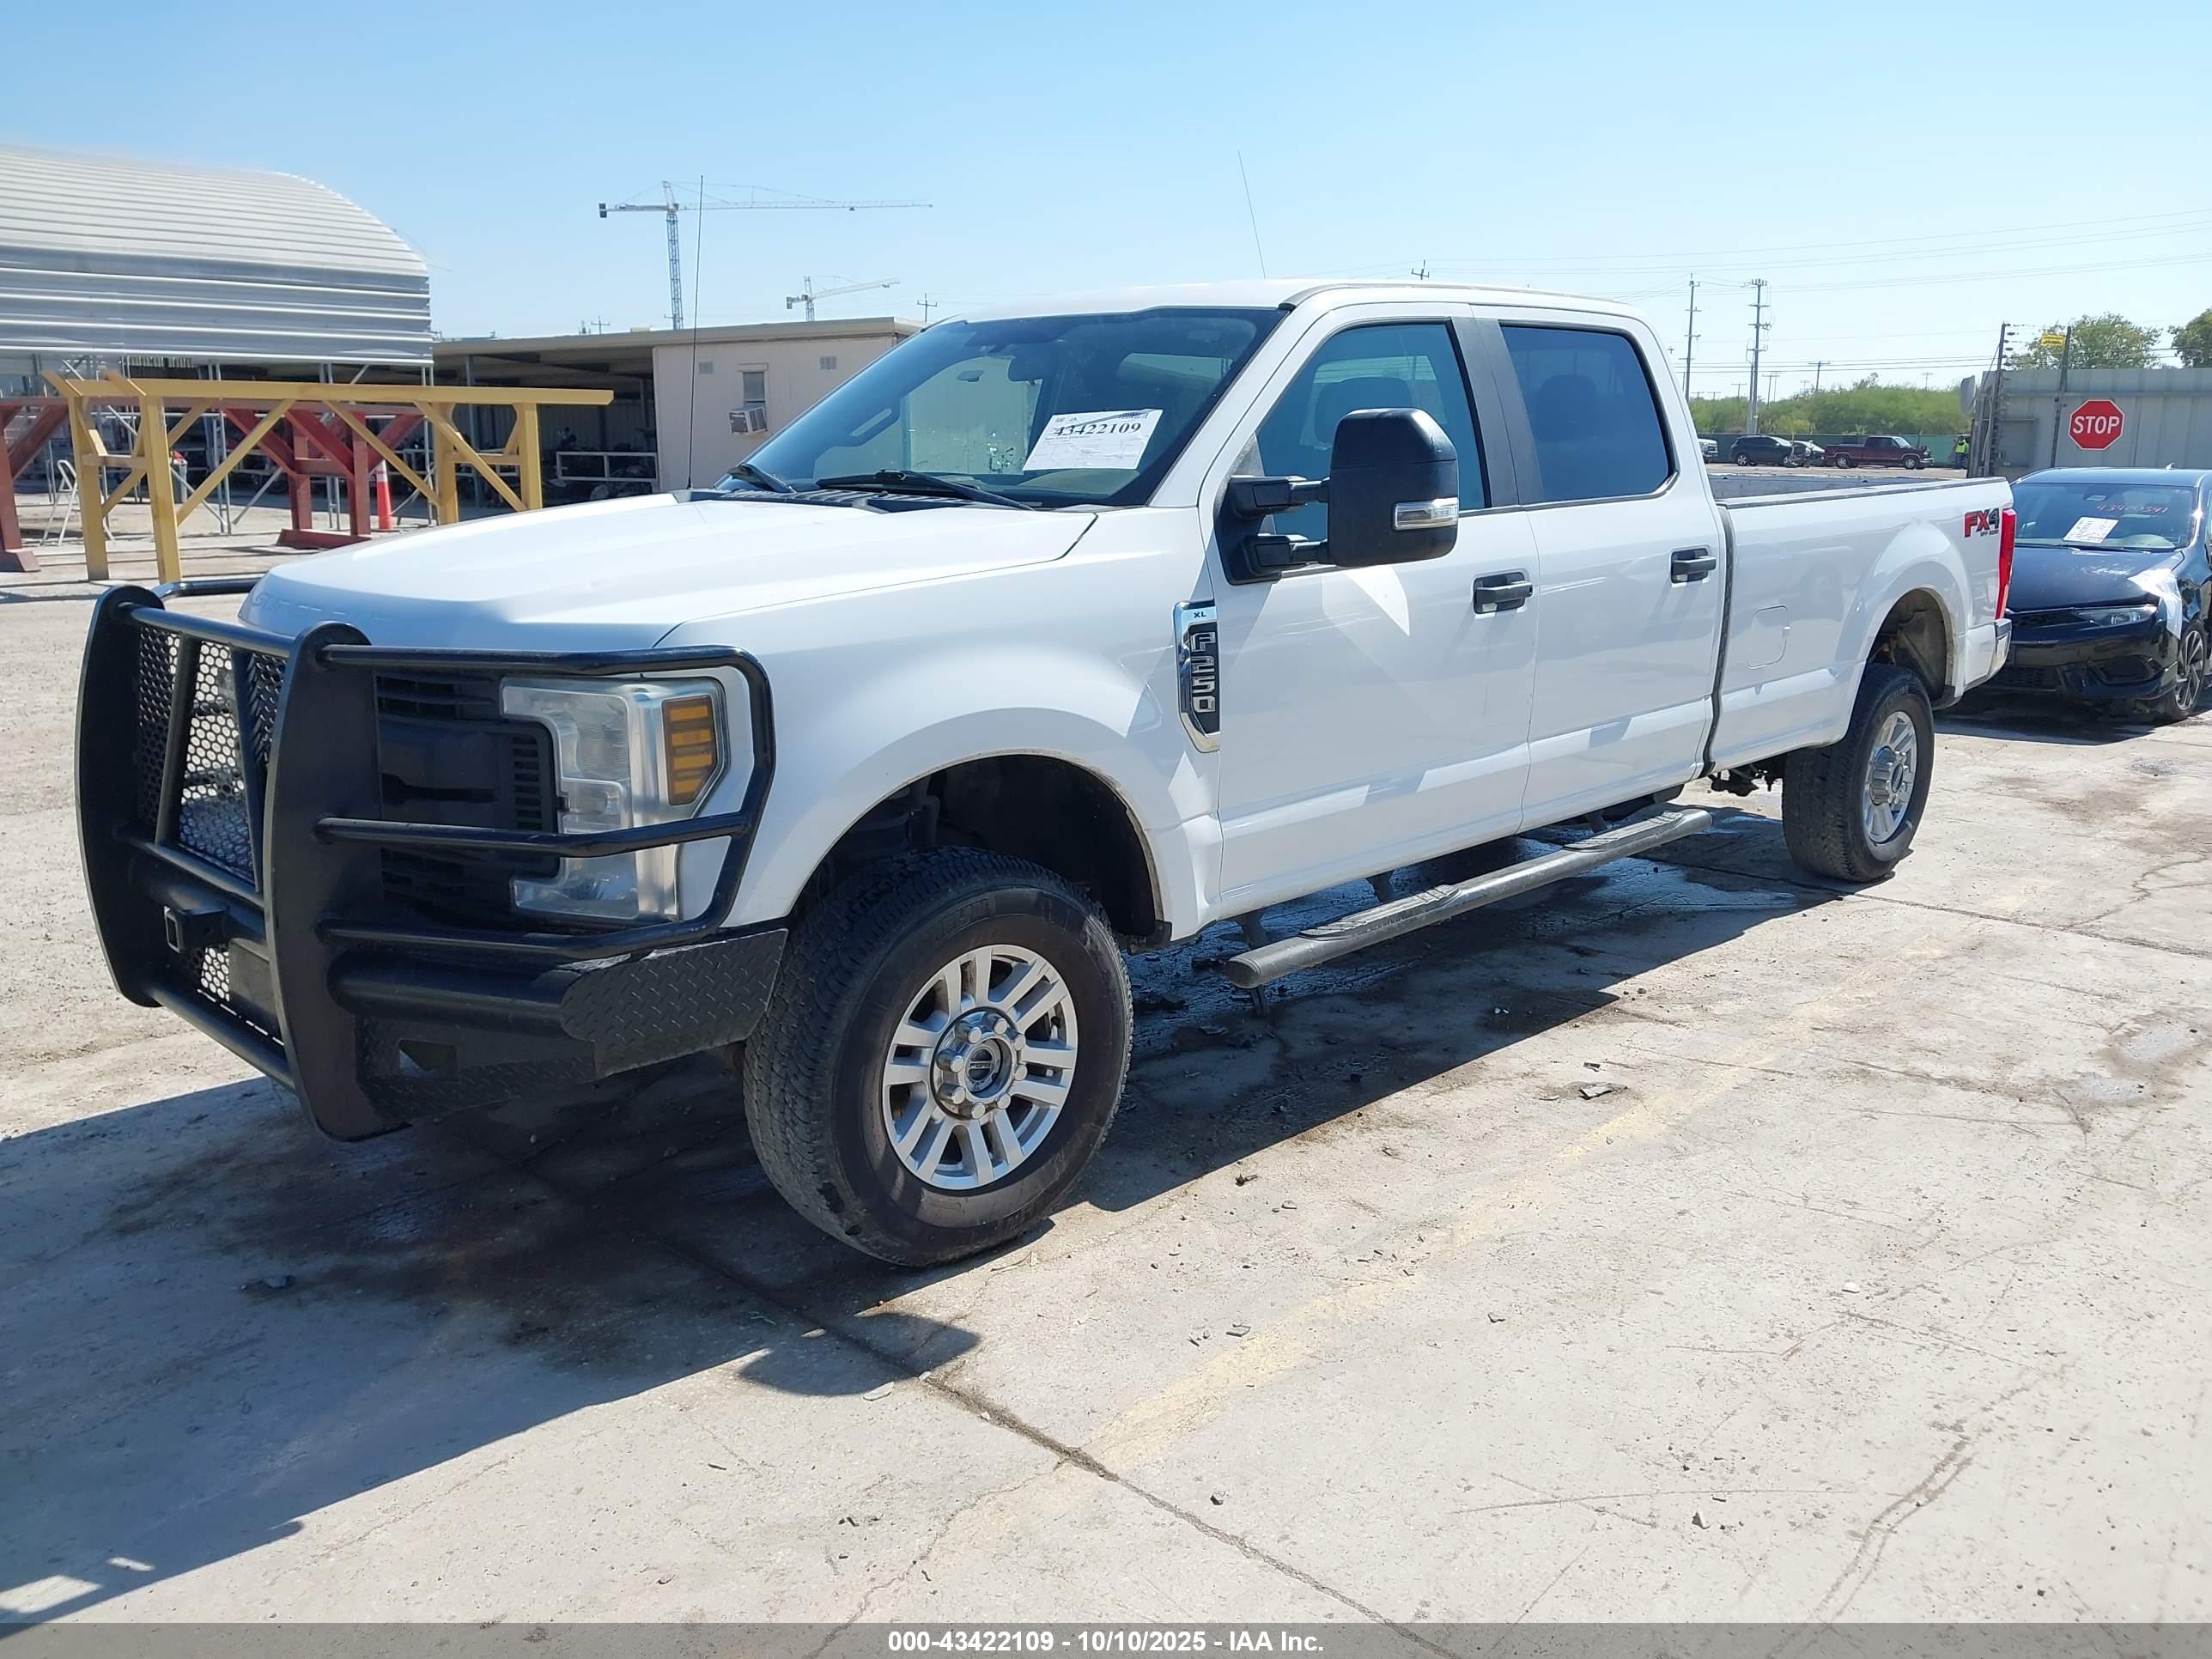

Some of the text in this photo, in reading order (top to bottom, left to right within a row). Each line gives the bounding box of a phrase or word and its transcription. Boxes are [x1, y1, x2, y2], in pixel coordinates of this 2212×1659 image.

[1054, 422, 1141, 436] 43422109
[2072, 416, 2120, 434] STOP
[1965, 507, 2000, 538] FX4
